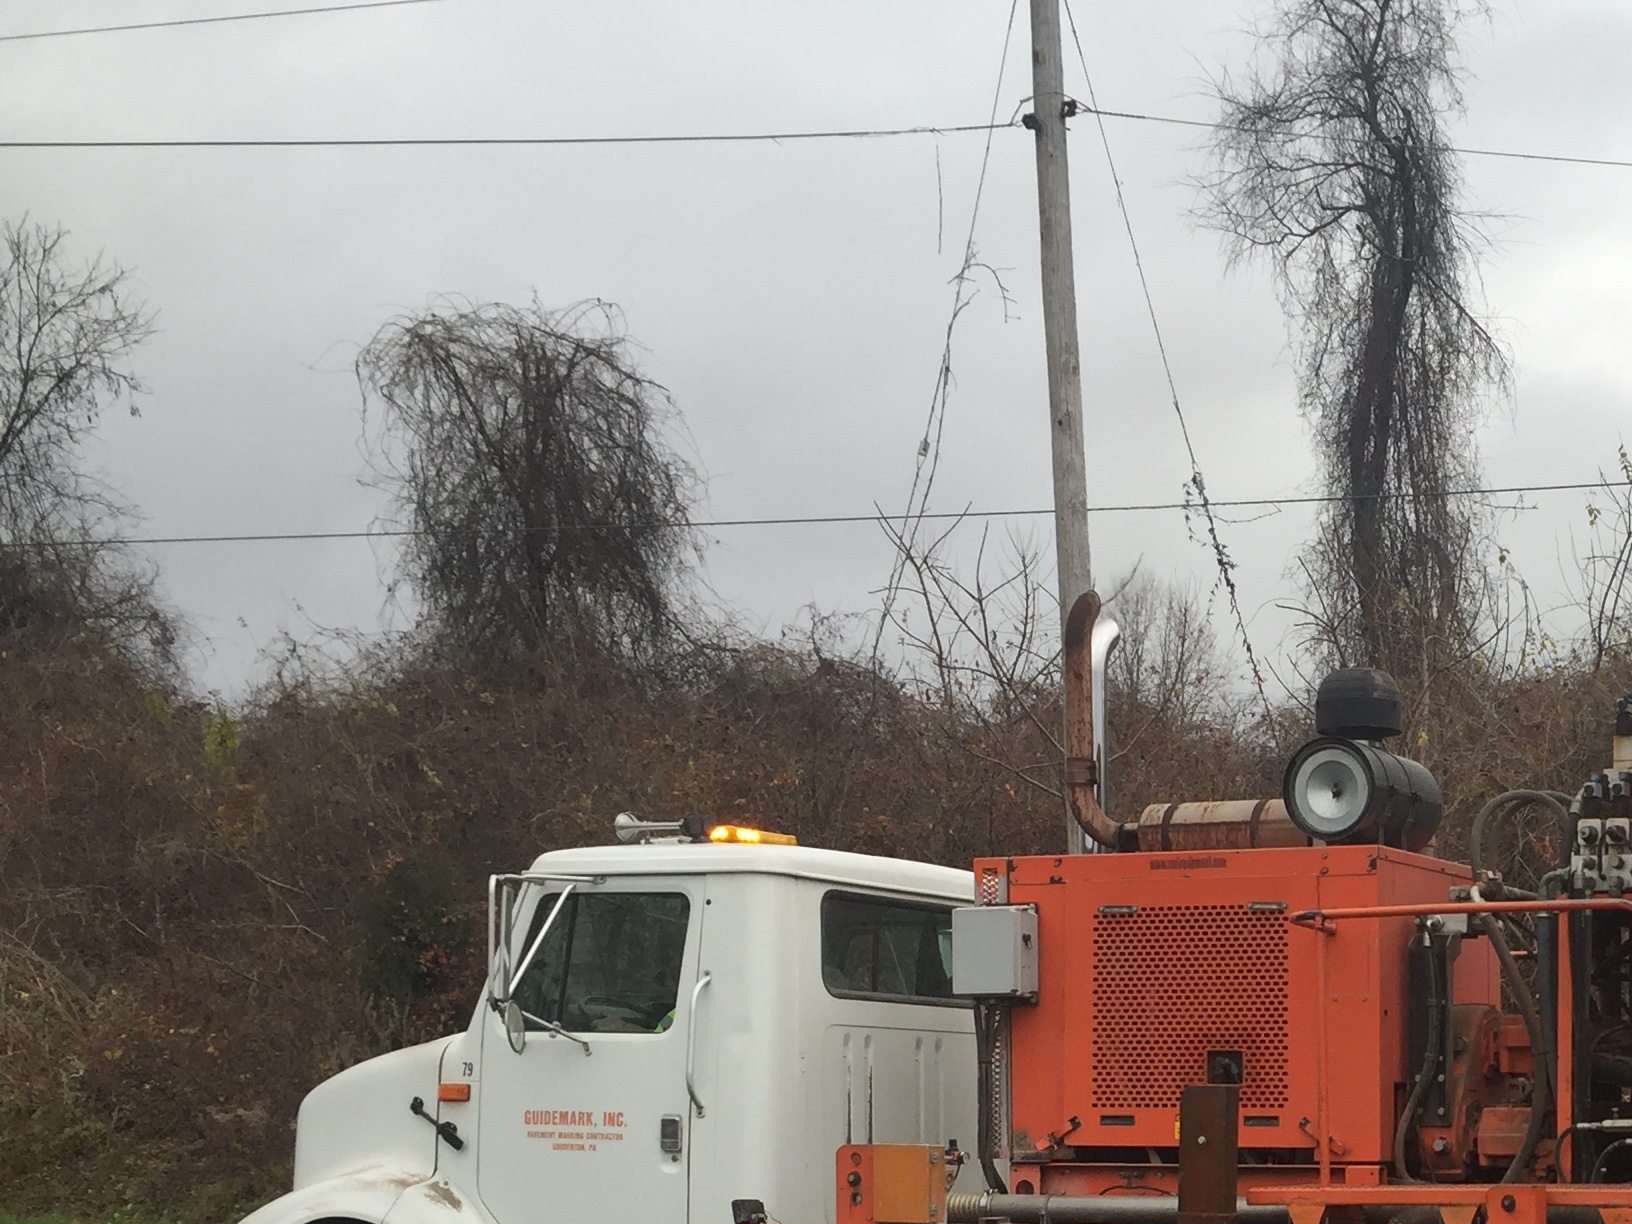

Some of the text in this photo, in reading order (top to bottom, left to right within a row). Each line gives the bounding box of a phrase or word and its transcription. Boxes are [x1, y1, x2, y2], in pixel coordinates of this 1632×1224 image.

[462, 1061, 474, 1077] 79
[523, 1109, 628, 1128] GUIDEMARK, INC.
[585, 1132, 624, 1141] CONTRACTOR
